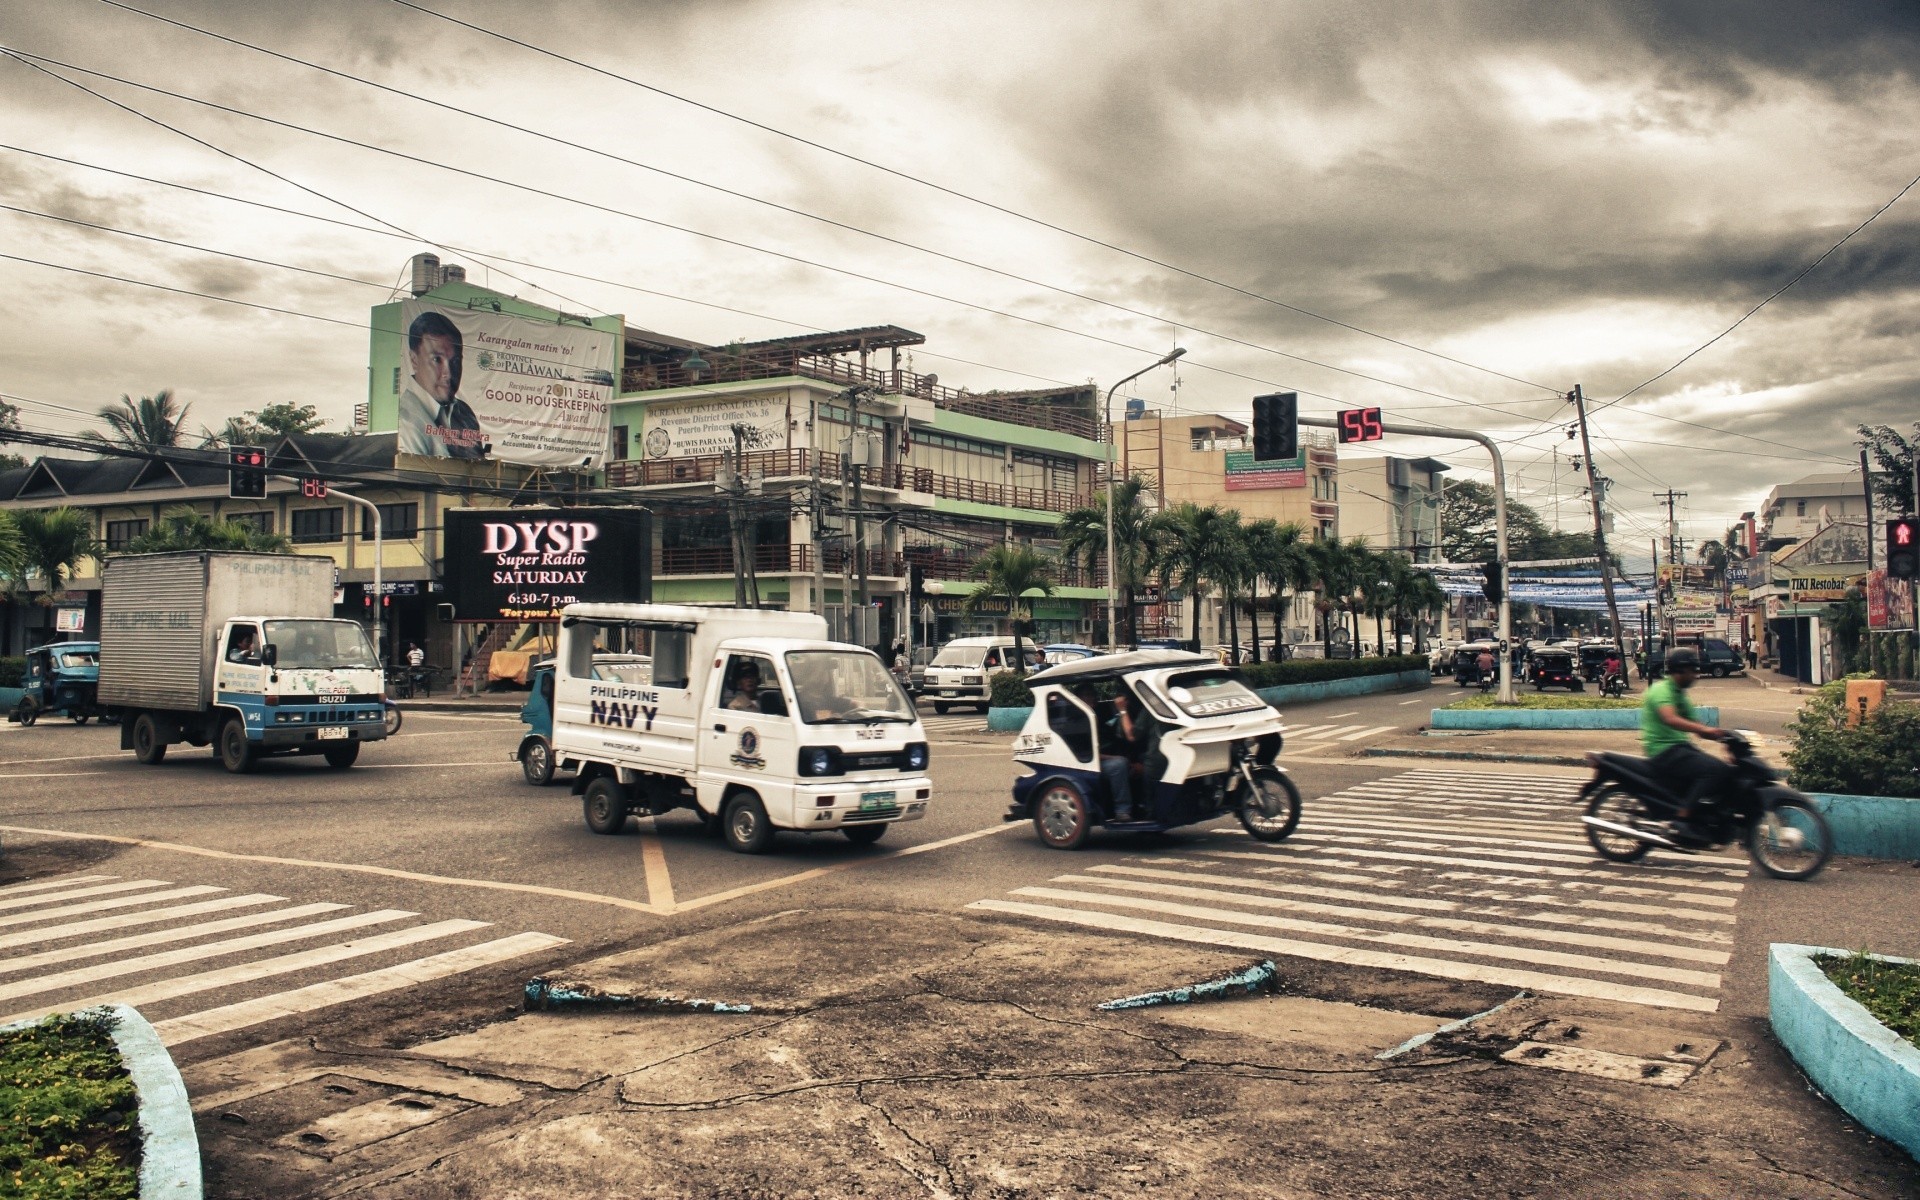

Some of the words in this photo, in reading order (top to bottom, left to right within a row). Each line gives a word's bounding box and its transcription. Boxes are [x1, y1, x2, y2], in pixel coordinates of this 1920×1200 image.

[477, 332, 532, 350] Karangalan
[534, 343, 558, 354] natin
[496, 352, 533, 363] PROVINCE
[505, 361, 563, 378] PALAWAN
[508, 381, 536, 392] Recipient
[537, 385, 545, 394] of
[577, 389, 600, 401] SEAL
[485, 389, 522, 403] GOOD
[526, 395, 608, 414] HOUSEKEEPING
[648, 406, 683, 417] BUREAU
[684, 406, 695, 414] OF
[696, 401, 741, 413] INTERNAL
[743, 397, 783, 408] REVENUE
[554, 410, 591, 424] Award
[661, 417, 691, 426] Revenue
[692, 413, 720, 423] District
[721, 411, 744, 421] Office
[745, 410, 758, 419] No.
[760, 408, 770, 417] 36
[678, 426, 700, 435] Puerto
[1344, 407, 1381, 442] 55
[501, 440, 536, 450] Accountable
[543, 444, 574, 454] Transparent
[521, 433, 539, 442] Sound
[540, 435, 556, 443] Fiscal
[557, 437, 590, 447] Management
[699, 438, 717, 446] PARA
[718, 437, 727, 445] SA
[683, 446, 706, 456] BUHAY
[707, 446, 717, 454] AT
[481, 521, 598, 554] DYSP
[496, 552, 539, 570] Super
[541, 552, 586, 566] Radio
[493, 570, 588, 585] SATURDAY
[1791, 578, 1809, 590] TIKI
[1809, 577, 1845, 590] Restobar
[381, 582, 397, 590] CLINIC
[508, 592, 550, 605] 6:30-7
[551, 594, 580, 606] p.m.
[981, 600, 1008, 612] DRUG
[523, 609, 550, 619] your
[1664, 603, 1677, 611] NOW
[109, 611, 164, 629] PHILIPPINE
[168, 611, 194, 629] MAIL
[318, 695, 347, 704] ISUZU
[590, 686, 659, 703] PHILIPPINE
[590, 700, 658, 731] NAVY
